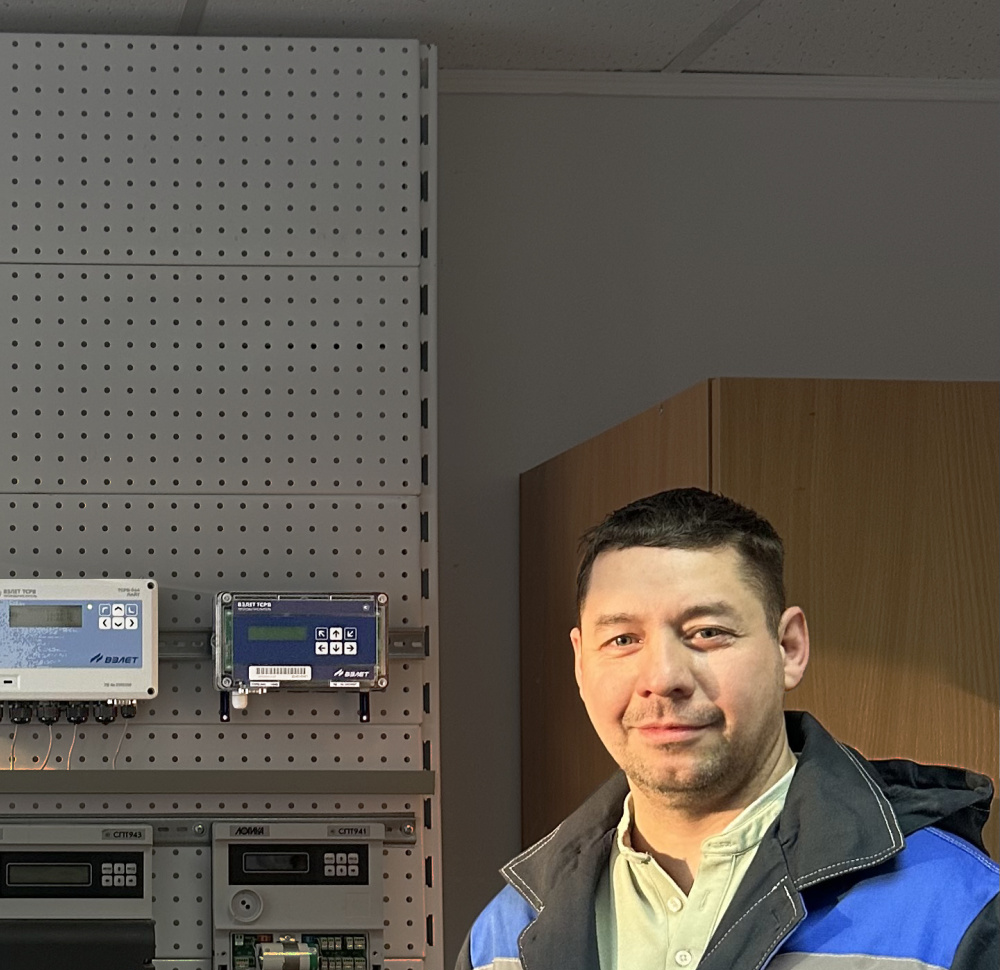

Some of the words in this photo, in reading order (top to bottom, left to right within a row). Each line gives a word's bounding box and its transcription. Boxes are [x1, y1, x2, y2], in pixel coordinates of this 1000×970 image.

[104, 656, 139, 664] ВЗЛЕТ
[113, 831, 142, 839] СПТ943
[338, 827, 367, 835] СПТ941
